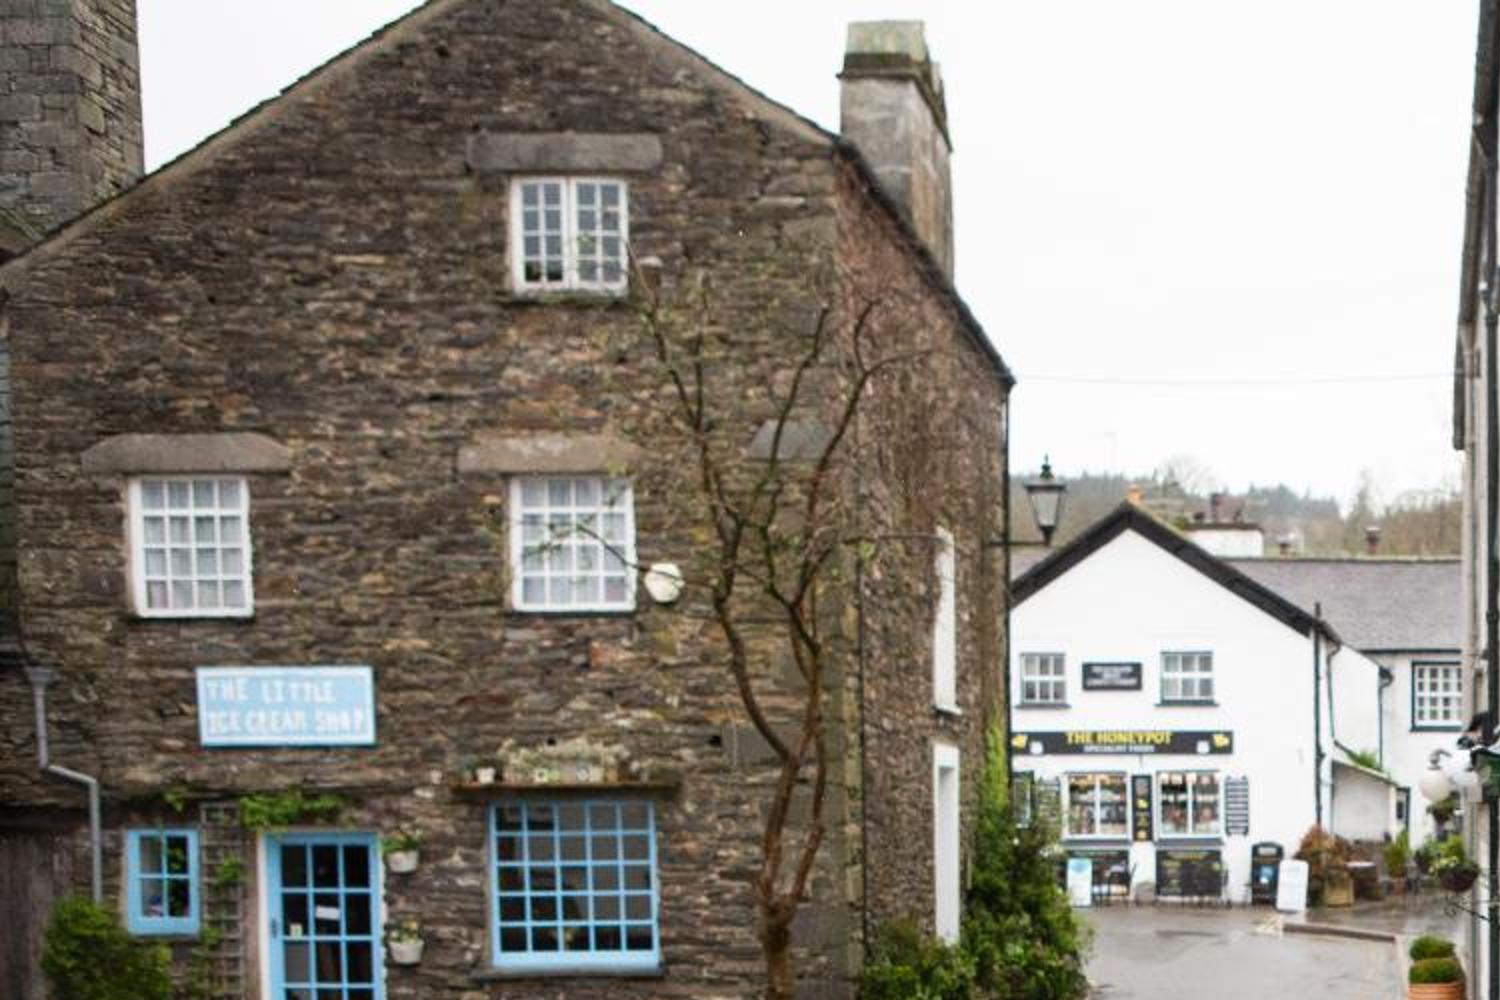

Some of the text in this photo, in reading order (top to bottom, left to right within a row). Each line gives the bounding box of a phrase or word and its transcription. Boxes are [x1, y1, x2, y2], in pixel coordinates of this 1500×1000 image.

[205, 677, 337, 704] THE LITTLE
[1066, 731, 1173, 745] THE HONEYPOT
